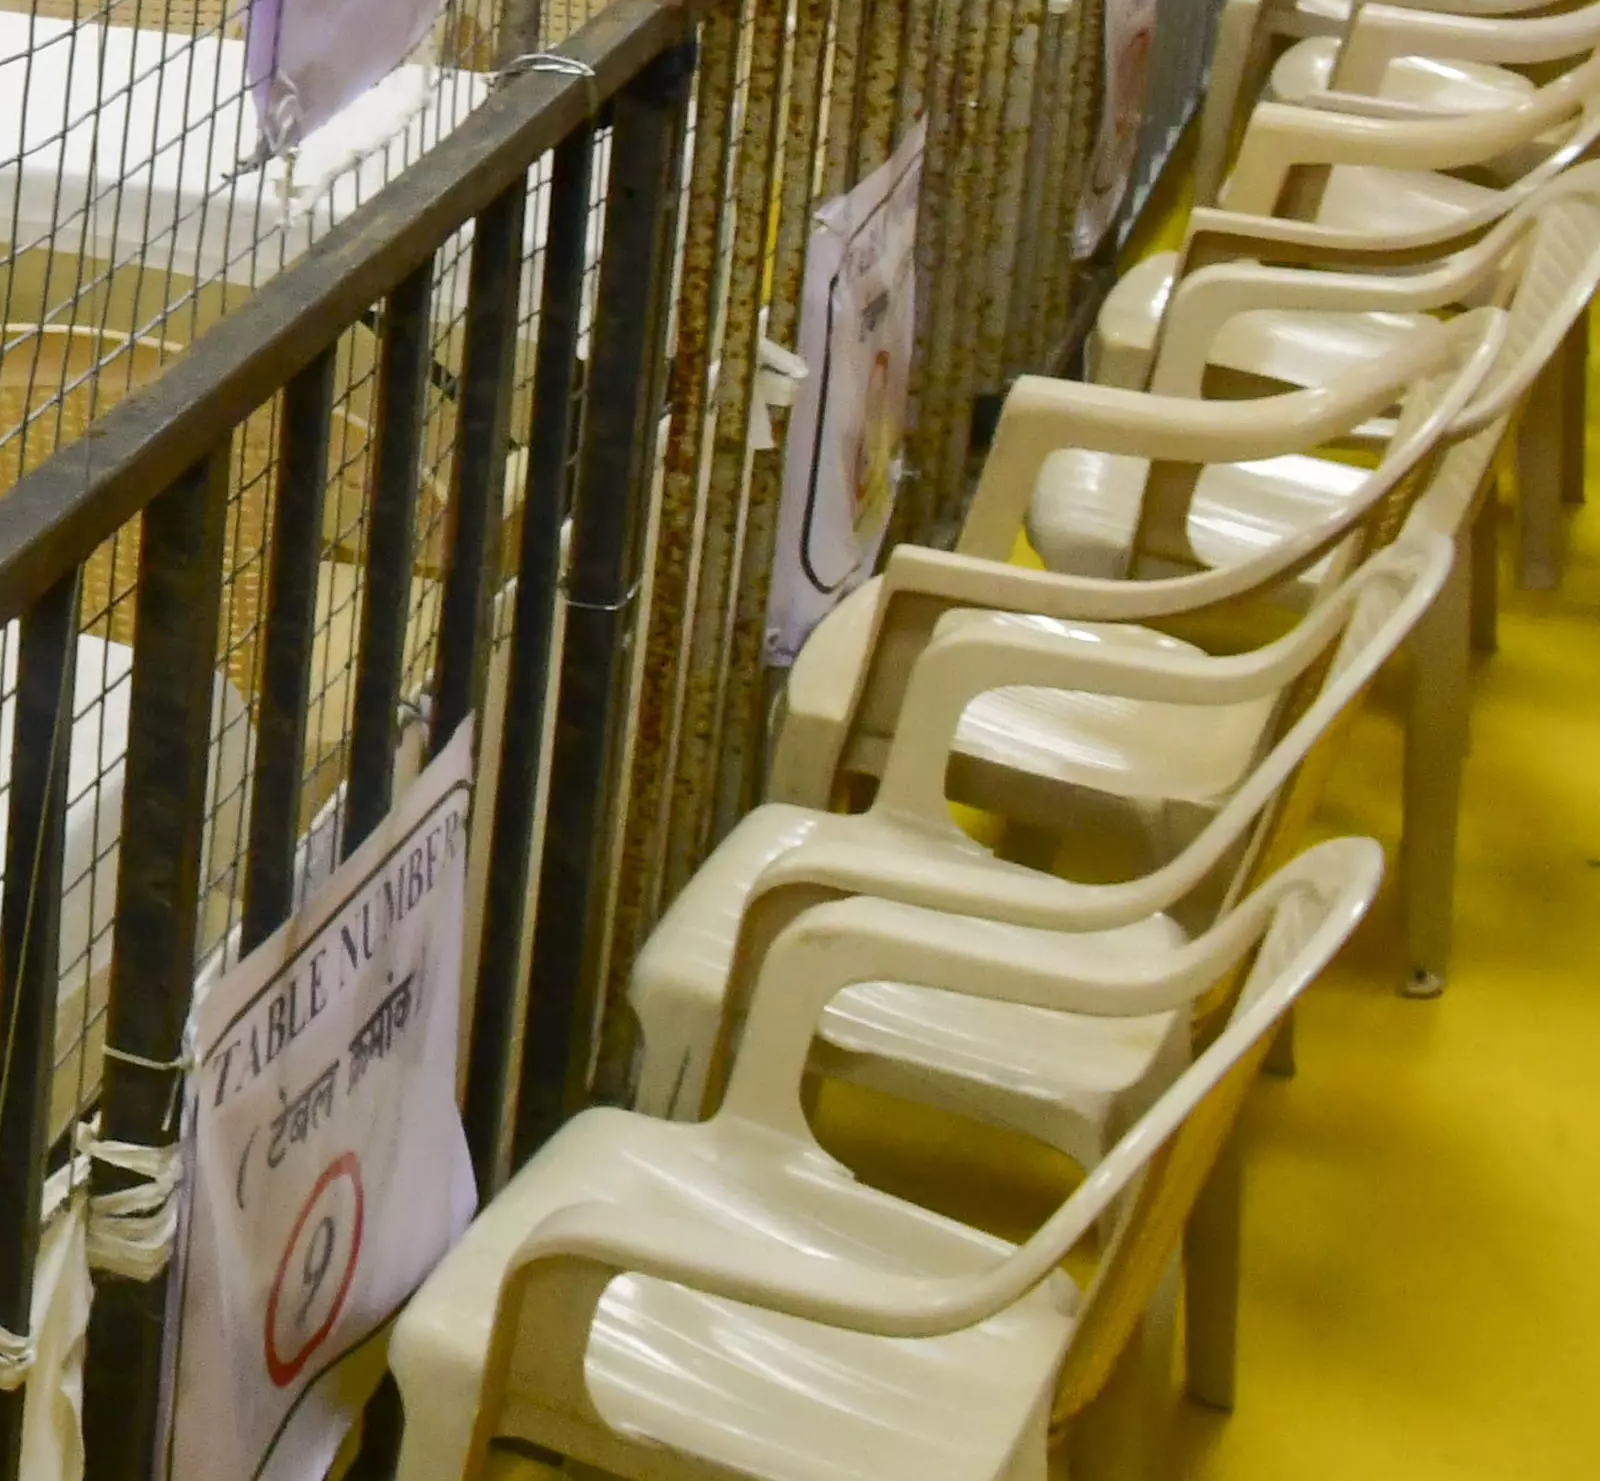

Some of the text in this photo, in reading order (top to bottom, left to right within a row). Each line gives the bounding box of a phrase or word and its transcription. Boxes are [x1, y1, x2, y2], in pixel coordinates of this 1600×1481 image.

[213, 810, 460, 1108] TABLE NUMBER
[295, 1216, 336, 1326] 9
